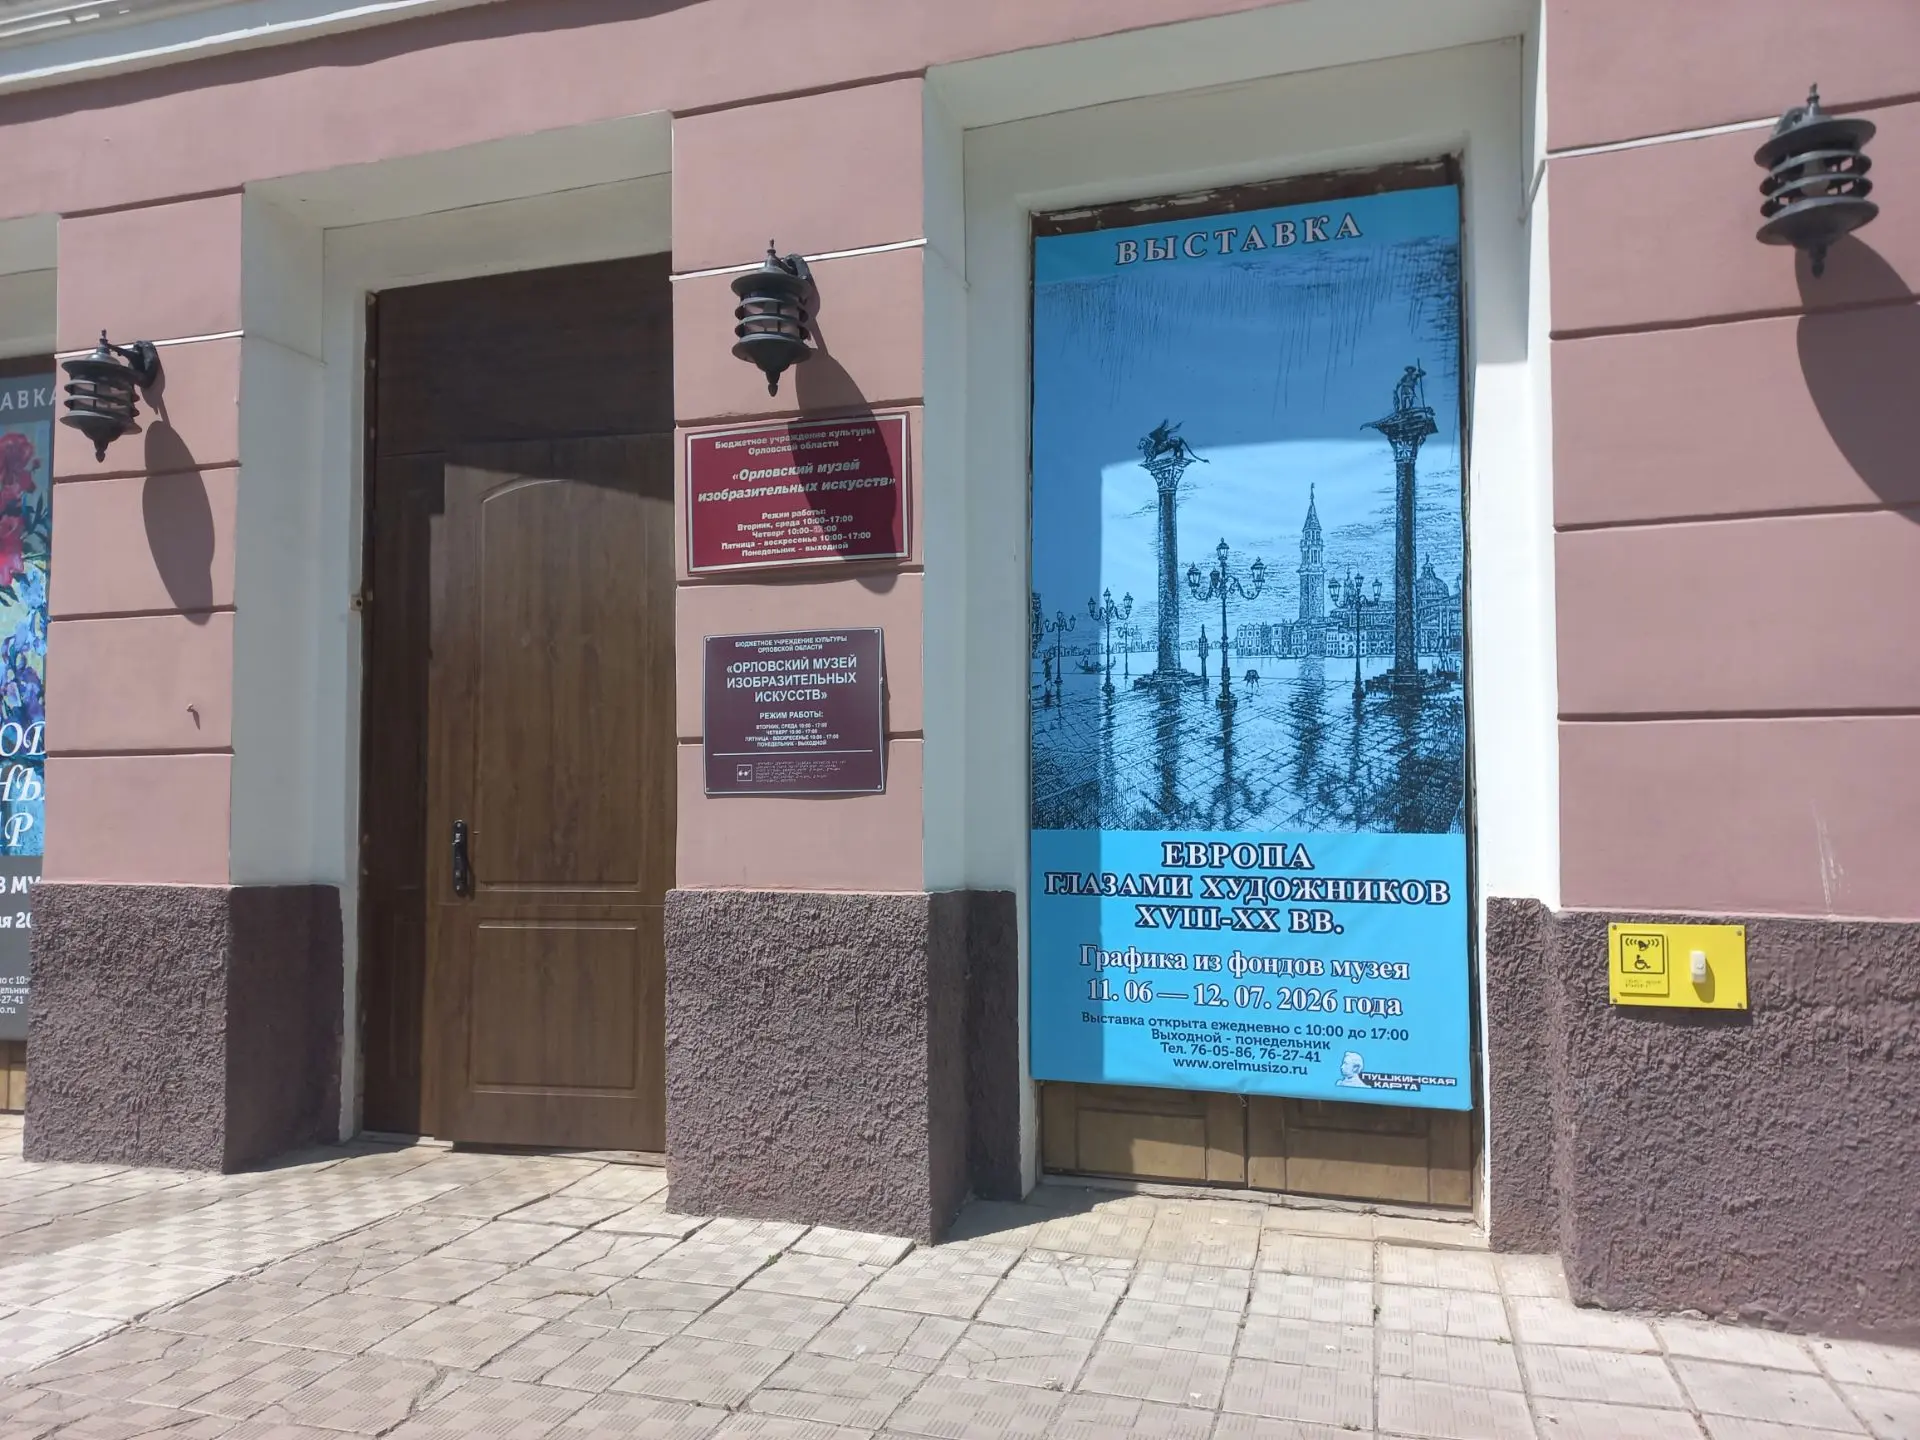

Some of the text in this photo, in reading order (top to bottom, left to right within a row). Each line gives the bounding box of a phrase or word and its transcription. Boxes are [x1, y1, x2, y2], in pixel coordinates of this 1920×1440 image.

[1115, 213, 1362, 265] ВЫСТАВКА
[715, 437, 767, 449] Бюджетное
[828, 428, 876, 440] культуры
[748, 440, 839, 456] Орловской области
[732, 458, 861, 483] «Орловский музей
[698, 475, 896, 502] изобразительных искусств»
[761, 511, 790, 520] Режим
[721, 541, 755, 550] Пятница
[742, 547, 796, 557] Понедельник
[805, 542, 849, 552] выходной
[726, 653, 857, 674] «ОРЛОВСКИЙ МУЗЕЙ
[726, 671, 857, 689] ИЗОБРАЗИТЕЛЬНЫХ
[754, 688, 828, 703] ИСКУССТВ»
[759, 710, 824, 720] РЕЖИМ РАБОТЫ:
[1161, 841, 1315, 870] ЕВРОПА
[1044, 872, 1451, 905] ГЛАЗАМИ ХУДОЖНИКОВ
[1135, 904, 1344, 934] XVIII-XX ВВ.
[1079, 943, 1410, 984] Графика из фондов музея
[1277, 987, 1338, 1012] 2026
[1344, 995, 1403, 1018] года
[1081, 1012, 1409, 1041] Выставка открыта ежедневно с 10:00 до 17:00
[1151, 1028, 1222, 1044] Выходной
[1235, 1036, 1331, 1050] понедельник
[1160, 1042, 1322, 1063] Тел. 76-05-86, 76-27-41
[1173, 1058, 1308, 1075] www.orelmusizo.ru
[1361, 1072, 1456, 1086] ПУШКИНСКАЯ
[1374, 1081, 1418, 1091] КАРТА
